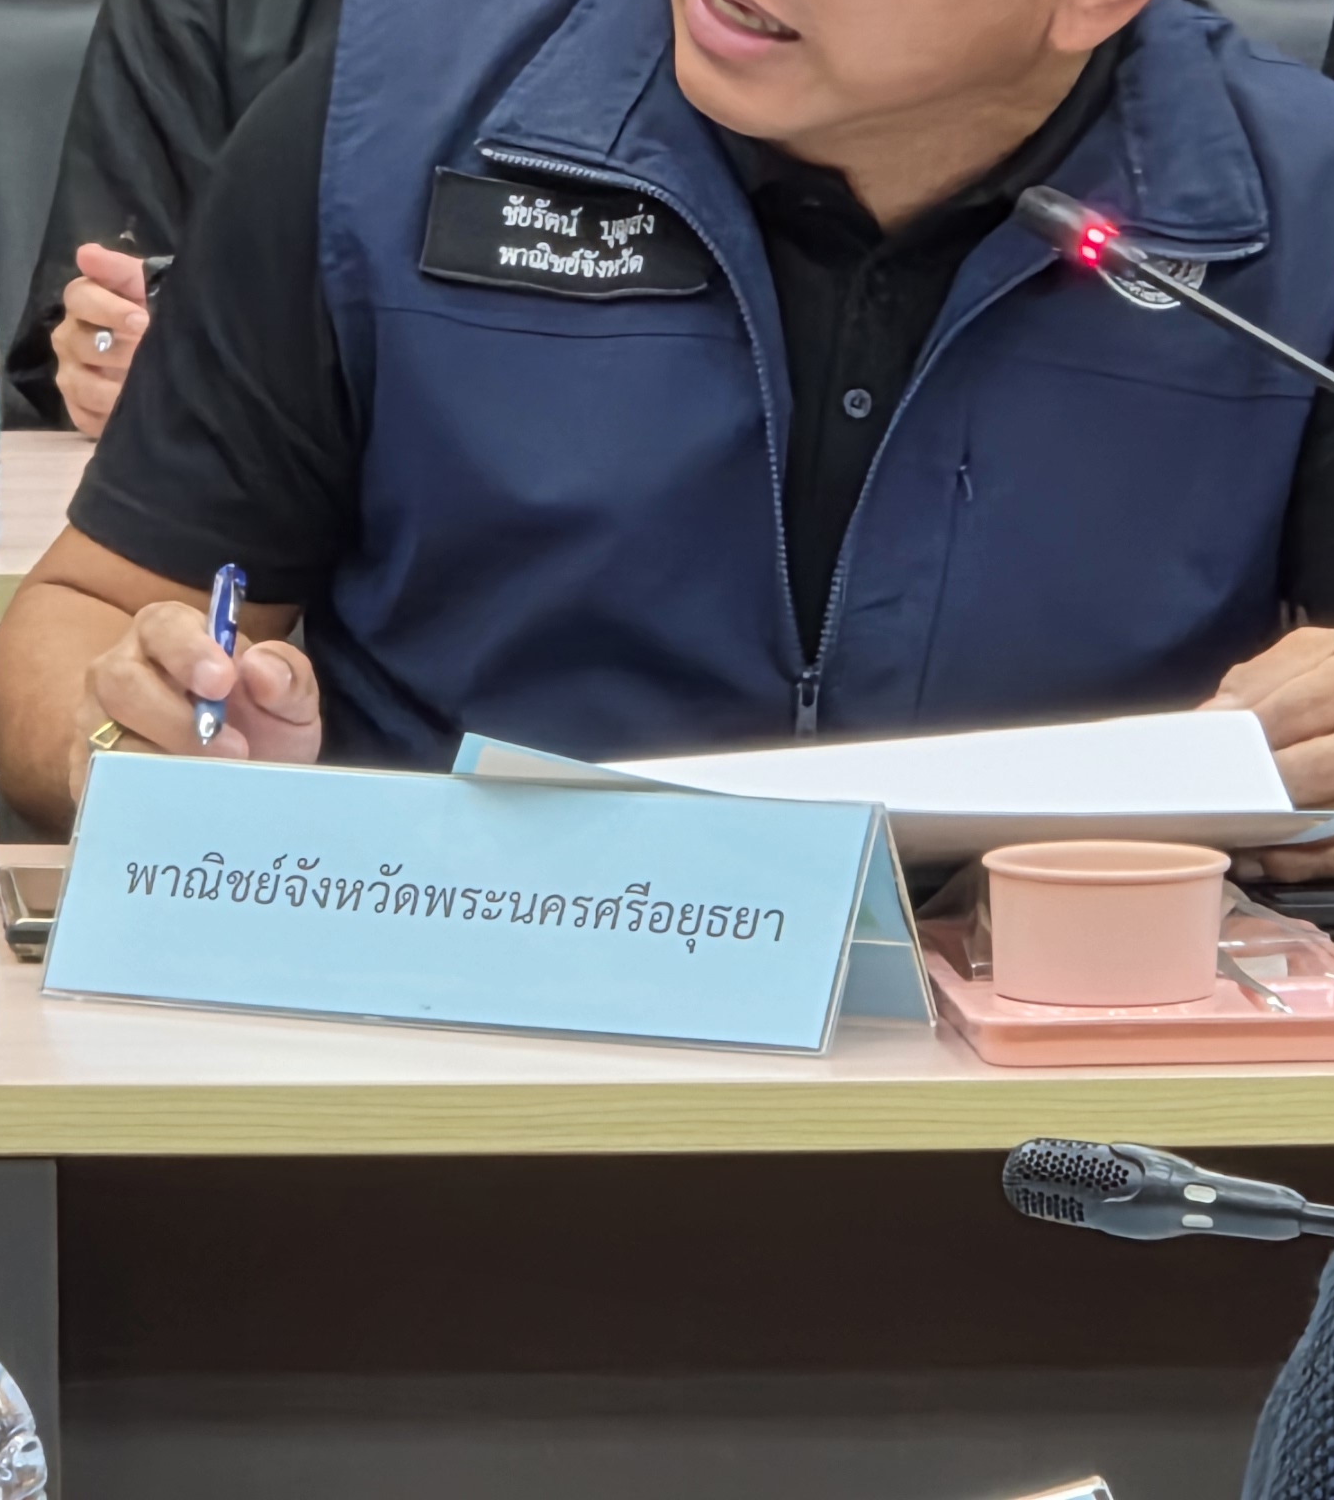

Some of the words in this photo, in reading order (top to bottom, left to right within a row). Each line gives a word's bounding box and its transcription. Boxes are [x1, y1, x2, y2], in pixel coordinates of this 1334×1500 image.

[502, 195, 583, 237] ชัยรัตน์
[499, 242, 644, 278] พาณิชย์จังหวัด
[125, 851, 786, 954] พาณิชย์จังหวัดพระนครศรีอยุธยา
